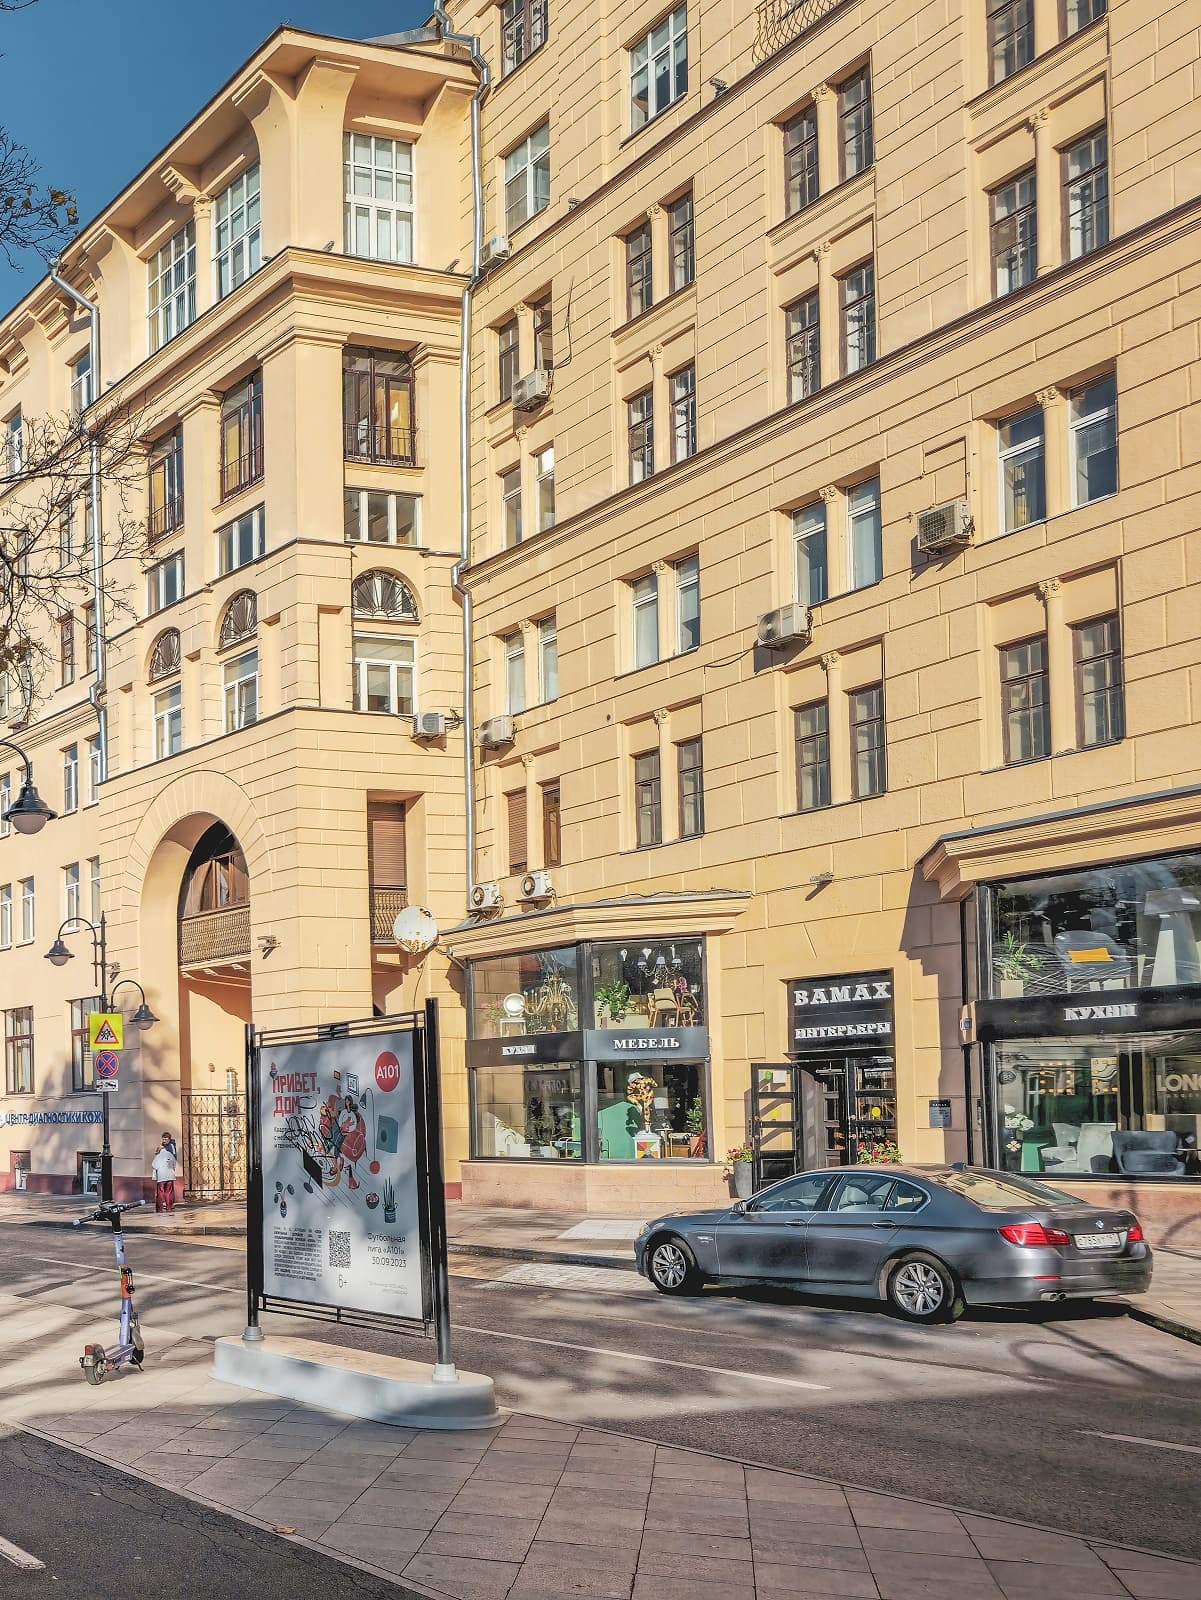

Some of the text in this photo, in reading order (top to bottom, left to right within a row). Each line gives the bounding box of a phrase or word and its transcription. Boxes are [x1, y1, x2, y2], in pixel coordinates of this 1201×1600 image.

[794, 982, 891, 1006] BAMAX
[1064, 1004, 1137, 1020] КУХНИ
[795, 1022, 892, 1039] ИНТЕРЬЕРЫ
[613, 1037, 680, 1049] МЕБЕЛЬ
[272, 1072, 320, 1094] ПРИВЕТ,
[1155, 1073, 1201, 1092] LON
[82, 1111, 103, 1124] КОЖ
[367, 1232, 406, 1243] Футбольная
